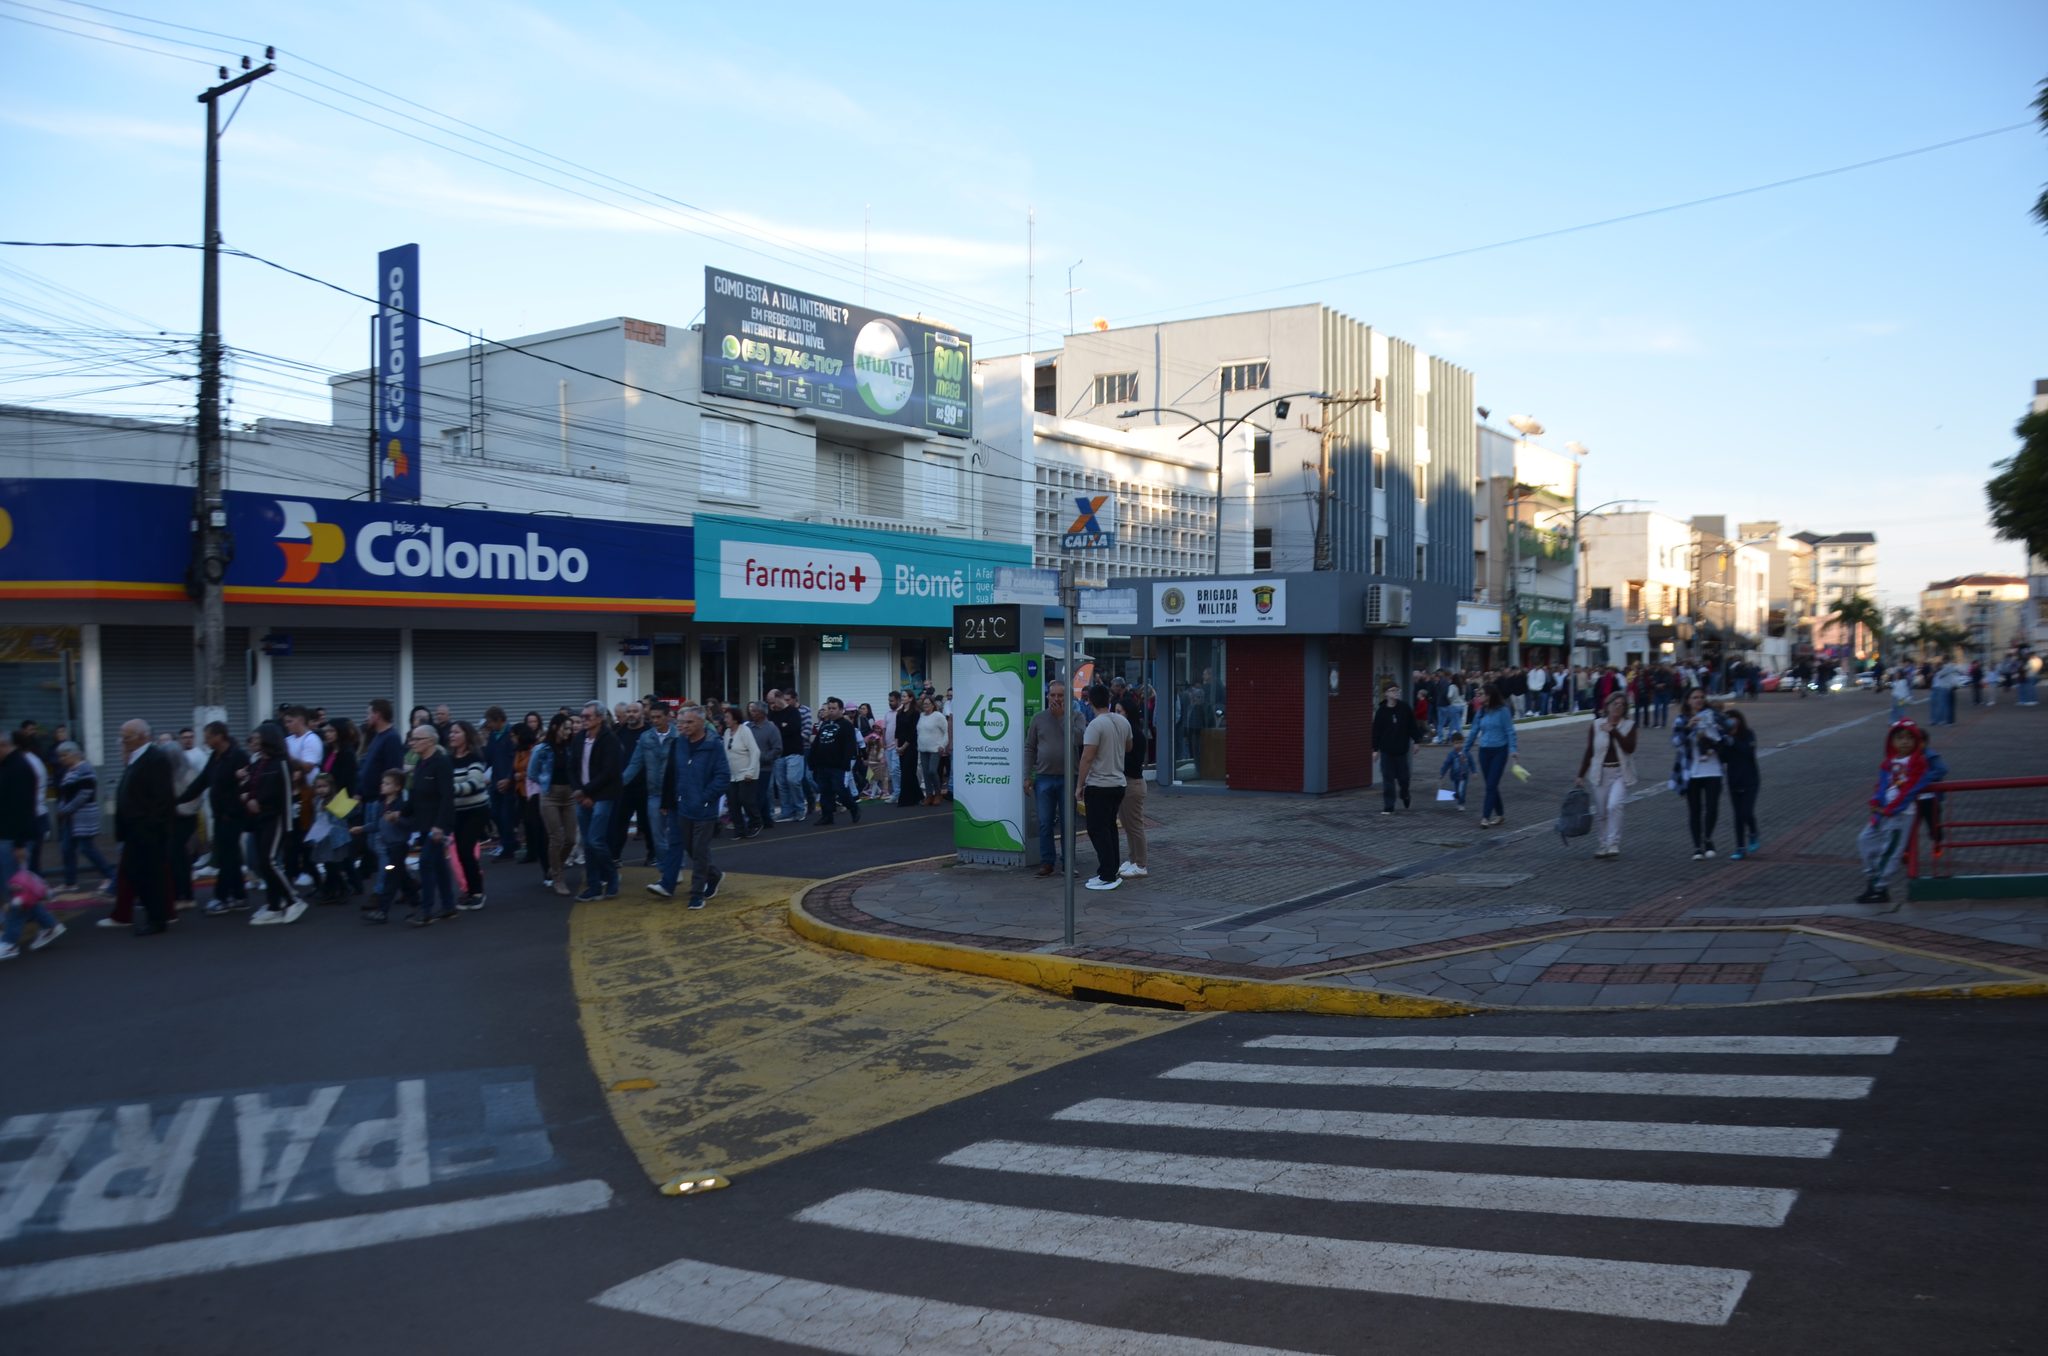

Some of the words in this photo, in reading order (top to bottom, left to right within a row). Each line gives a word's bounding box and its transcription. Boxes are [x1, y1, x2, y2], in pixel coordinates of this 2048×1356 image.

[714, 275, 743, 299] COMO
[745, 283, 769, 306] ESTÁ
[772, 290, 780, 309] A
[780, 292, 799, 313] TUA
[751, 307, 763, 320] EM
[763, 309, 801, 330] FREDERICO
[802, 319, 817, 333] TEM
[741, 320, 777, 339] INTERNET
[777, 328, 787, 341] DE
[788, 330, 805, 346] ALTO
[805, 333, 826, 350] NÍVEL
[385, 266, 405, 432] Colombo
[741, 338, 771, 366] (55)
[773, 345, 844, 376] 3746-1107
[856, 353, 913, 380] ATUATEC
[933, 345, 964, 381] 600
[935, 379, 960, 400] mega
[944, 404, 957, 425] 99
[393, 520, 416, 534] lojas
[355, 521, 589, 583] Colombo
[1064, 534, 1108, 548] CAIXA
[1197, 588, 1238, 601] BRIGADA
[1198, 602, 1238, 615] MILITAR
[965, 616, 1007, 639] 24°C
[964, 694, 1009, 741] 45
[977, 774, 1011, 785] Sicredi
[0, 1078, 433, 1242] PARE
